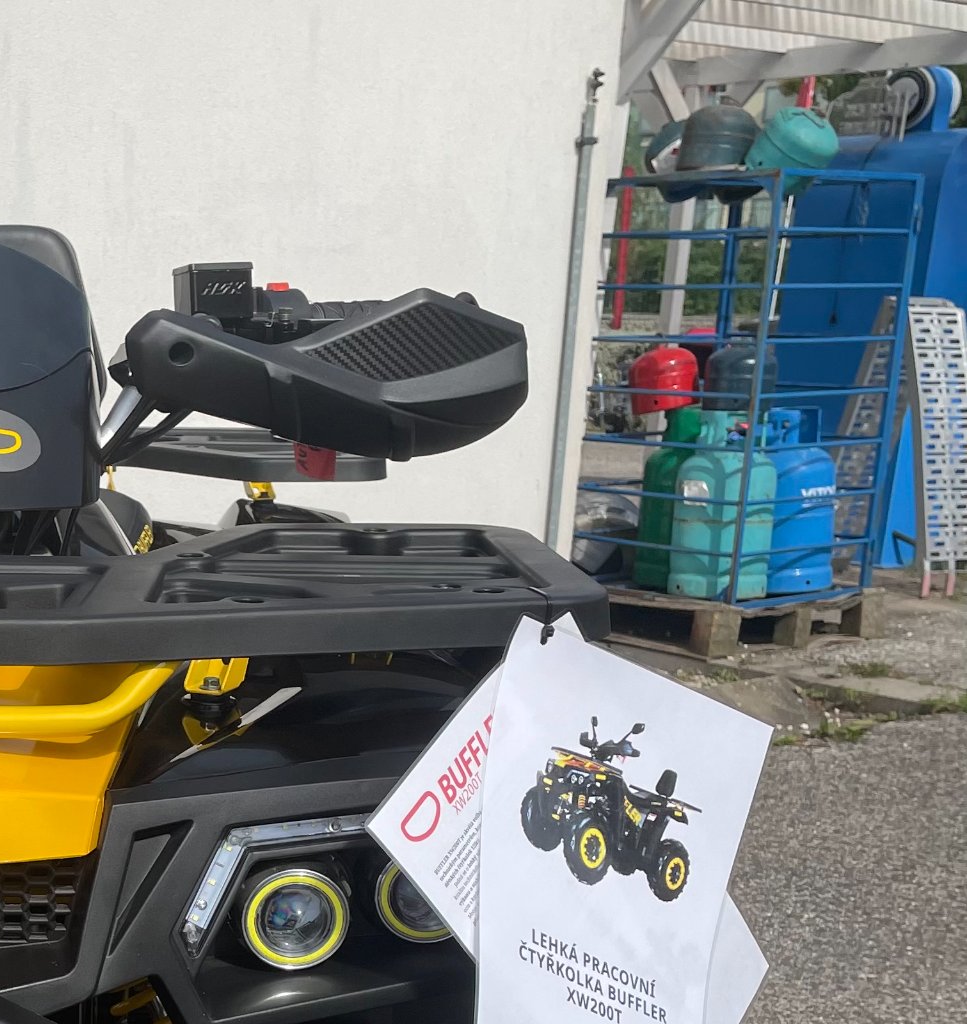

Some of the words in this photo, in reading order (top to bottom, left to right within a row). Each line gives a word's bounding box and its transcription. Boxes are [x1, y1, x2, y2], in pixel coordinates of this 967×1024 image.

[519, 940, 603, 996] ČTYŘKOLKA
[608, 984, 667, 1024] BUFFLER
[532, 928, 578, 964] LEHKÁ
[583, 952, 656, 998] PRACOVNÍ
[566, 986, 622, 1024] XW200T
